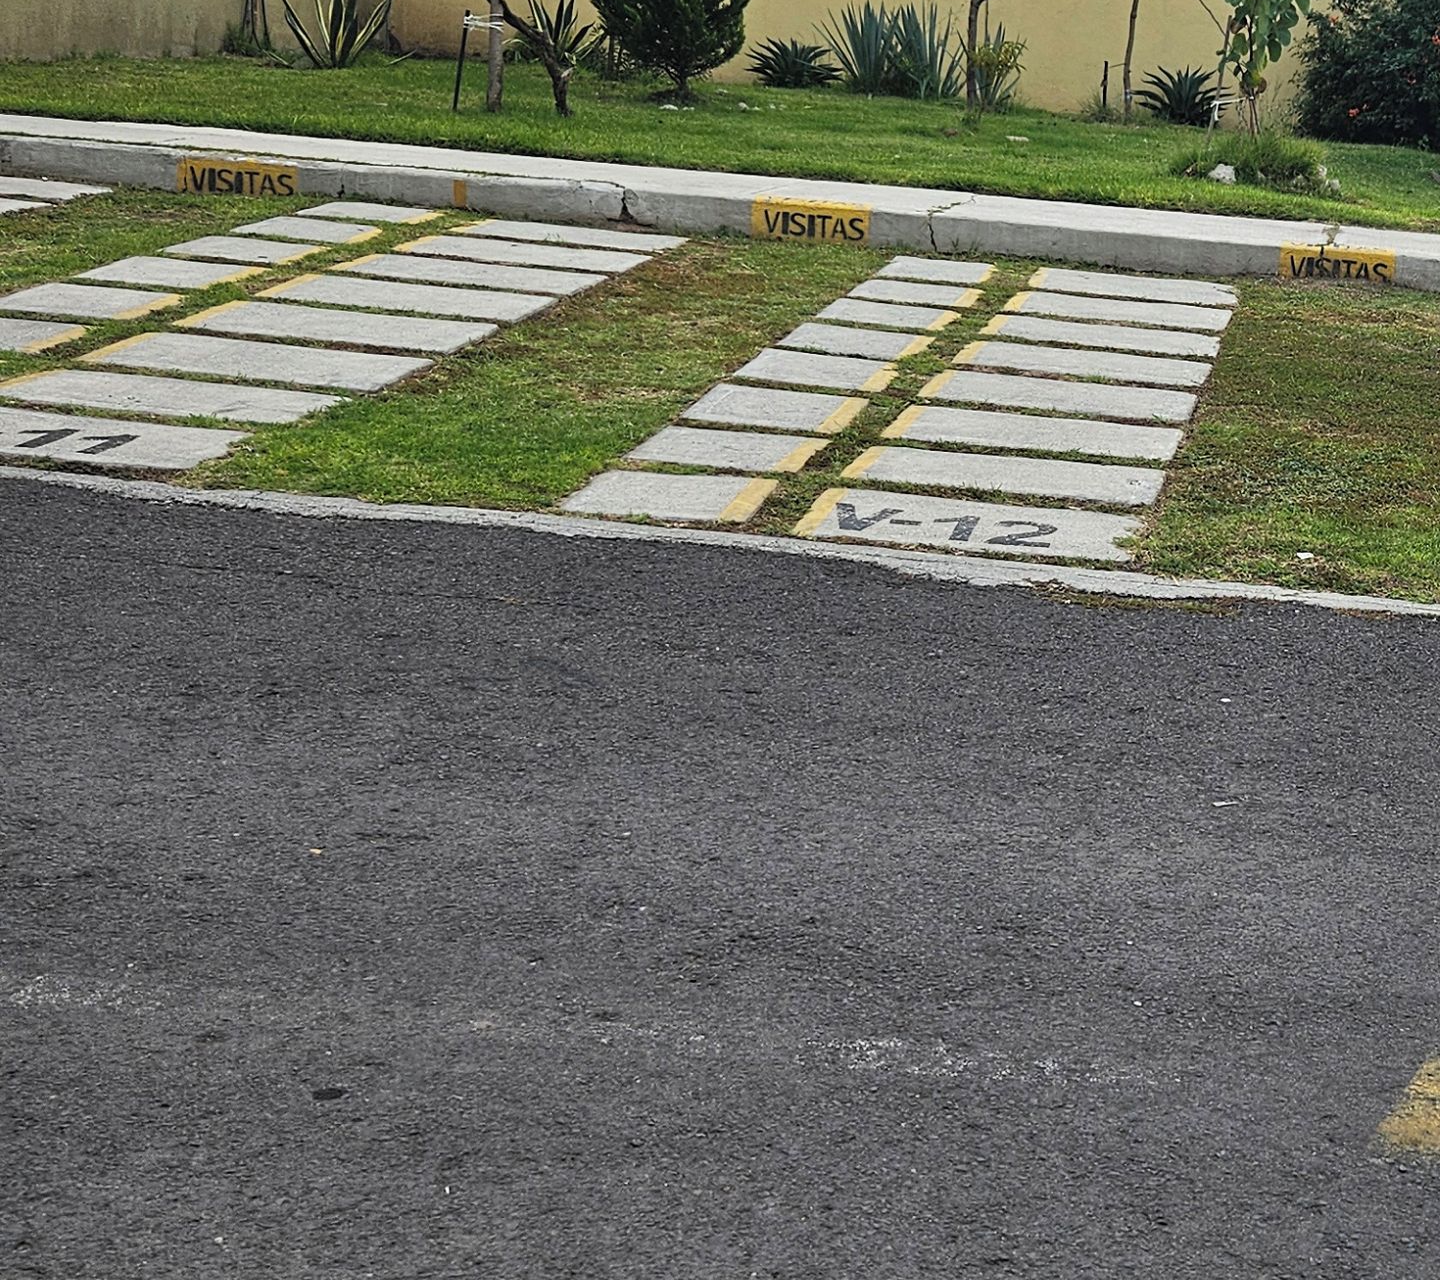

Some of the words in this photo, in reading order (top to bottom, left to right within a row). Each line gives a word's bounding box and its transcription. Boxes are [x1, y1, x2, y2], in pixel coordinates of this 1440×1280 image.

[189, 165, 295, 196] VISITAS
[764, 209, 865, 241] VISITAS
[1290, 255, 1389, 282] VISITAS
[0, 428, 141, 455] 11
[836, 502, 1058, 548] V-12
